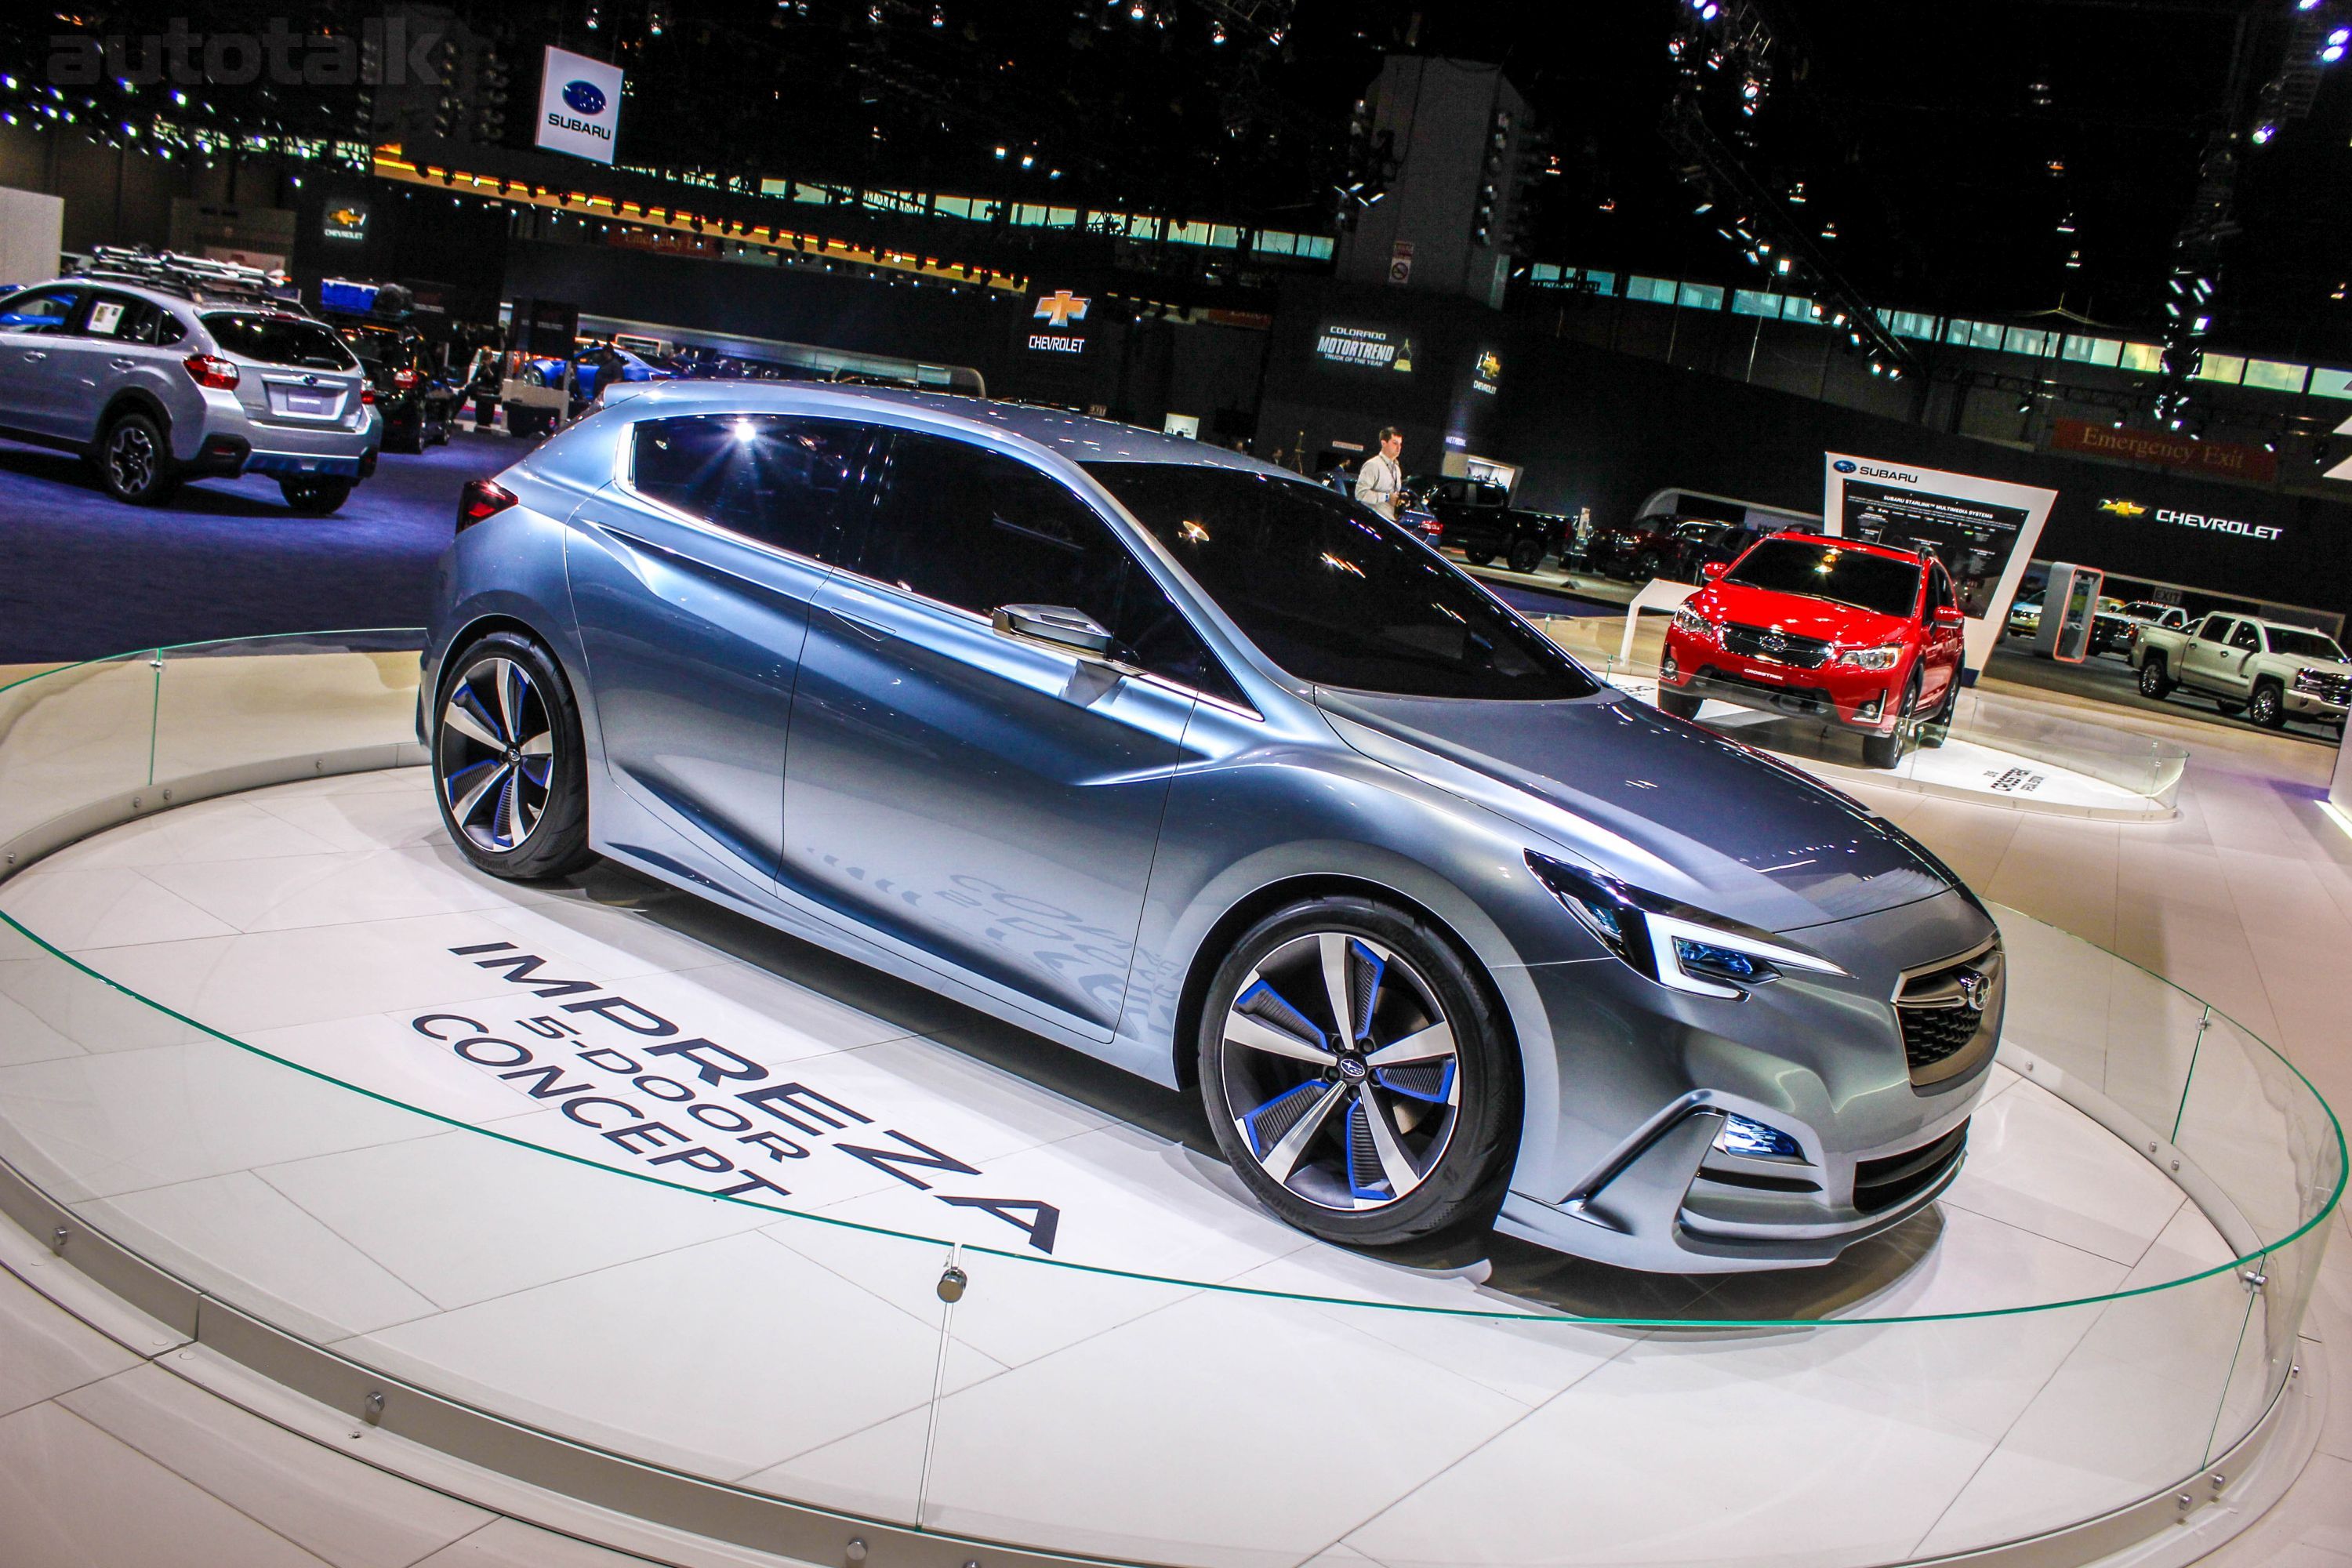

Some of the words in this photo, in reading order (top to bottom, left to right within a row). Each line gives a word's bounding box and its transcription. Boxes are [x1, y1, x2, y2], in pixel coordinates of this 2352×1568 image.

[548, 113, 612, 140] SUBARU
[1028, 335, 1085, 354] CHEVROLET
[1330, 325, 1387, 340] COLORADO
[1317, 336, 1395, 361] MOTORTREND
[2082, 426, 2194, 463] Emergency
[2203, 445, 2245, 469] Exit
[1859, 466, 1918, 484] SUBARU
[1883, 495, 1905, 503] SUBARU
[1936, 504, 1968, 514] MULTIMEDIA
[1969, 510, 1994, 519] SYSTEMS
[2155, 509, 2283, 540] CHEVROLET
[447, 942, 1061, 1255] IMPREZA
[514, 1015, 811, 1163] 5-DOOR
[412, 1014, 793, 1197] CONCEPT
